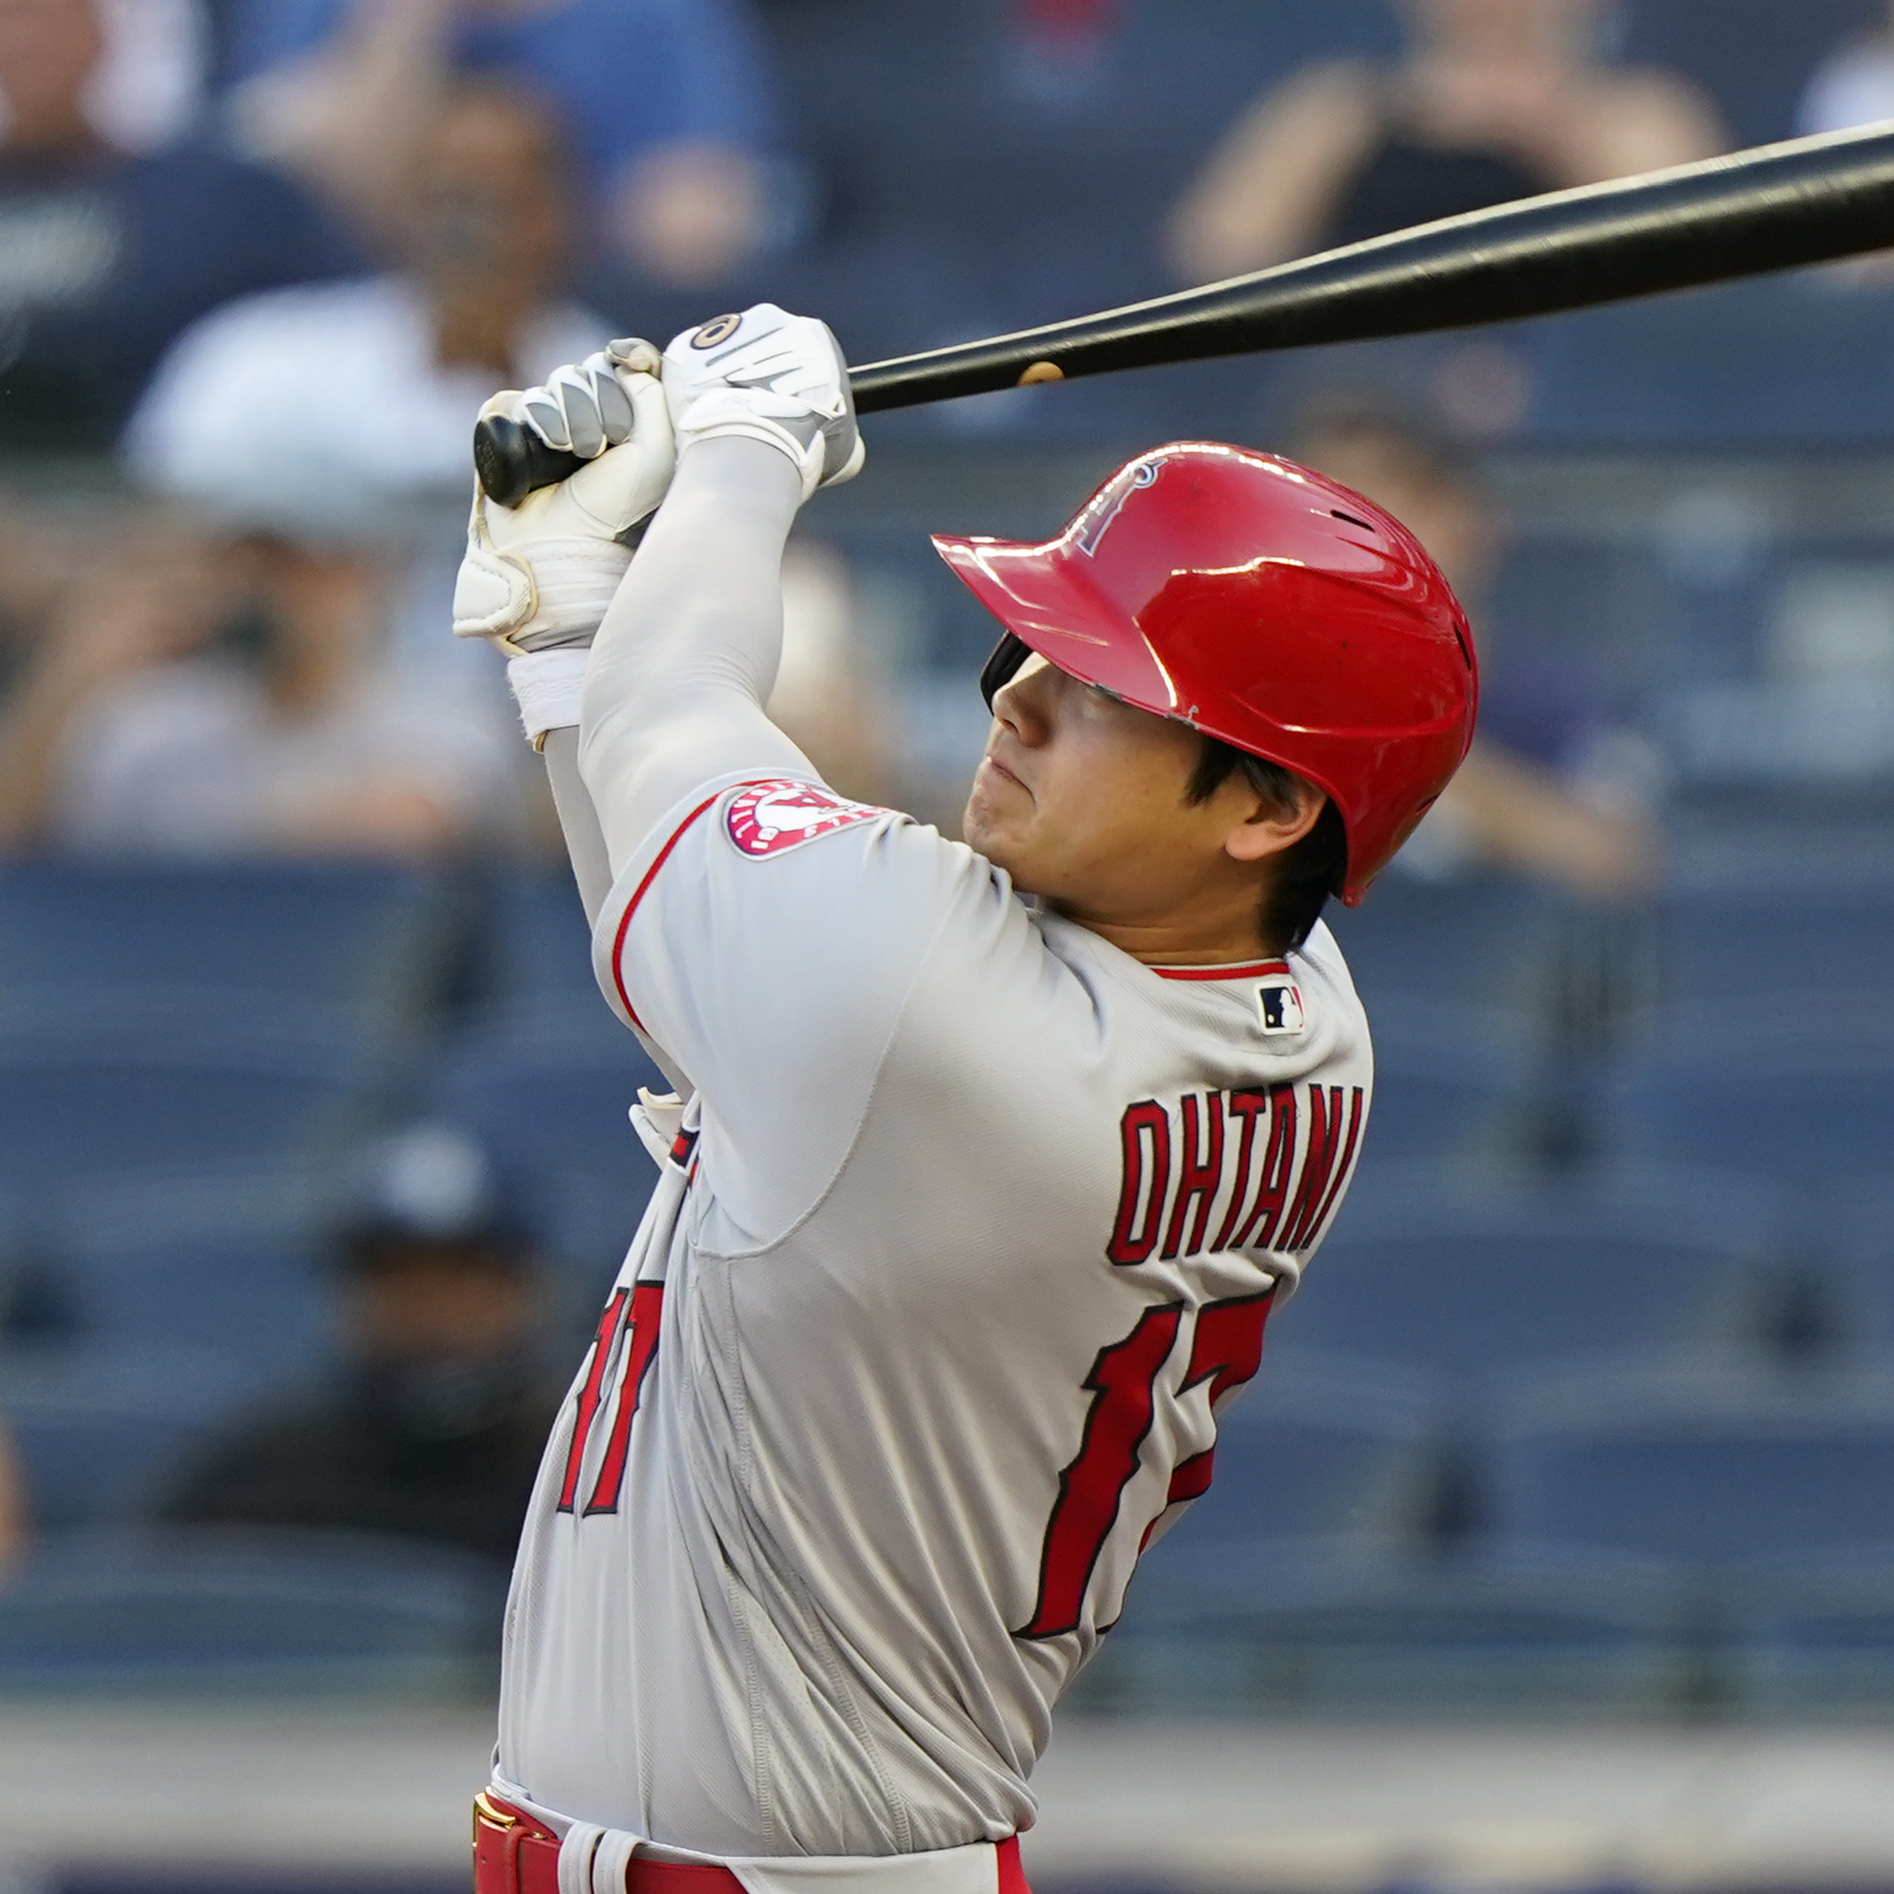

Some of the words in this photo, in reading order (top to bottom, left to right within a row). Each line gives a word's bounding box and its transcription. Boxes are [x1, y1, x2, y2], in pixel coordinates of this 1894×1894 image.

[1106, 1083, 1364, 1267] OHTANI
[554, 1280, 665, 1519] 17
[1010, 1277, 1281, 1641] 17
